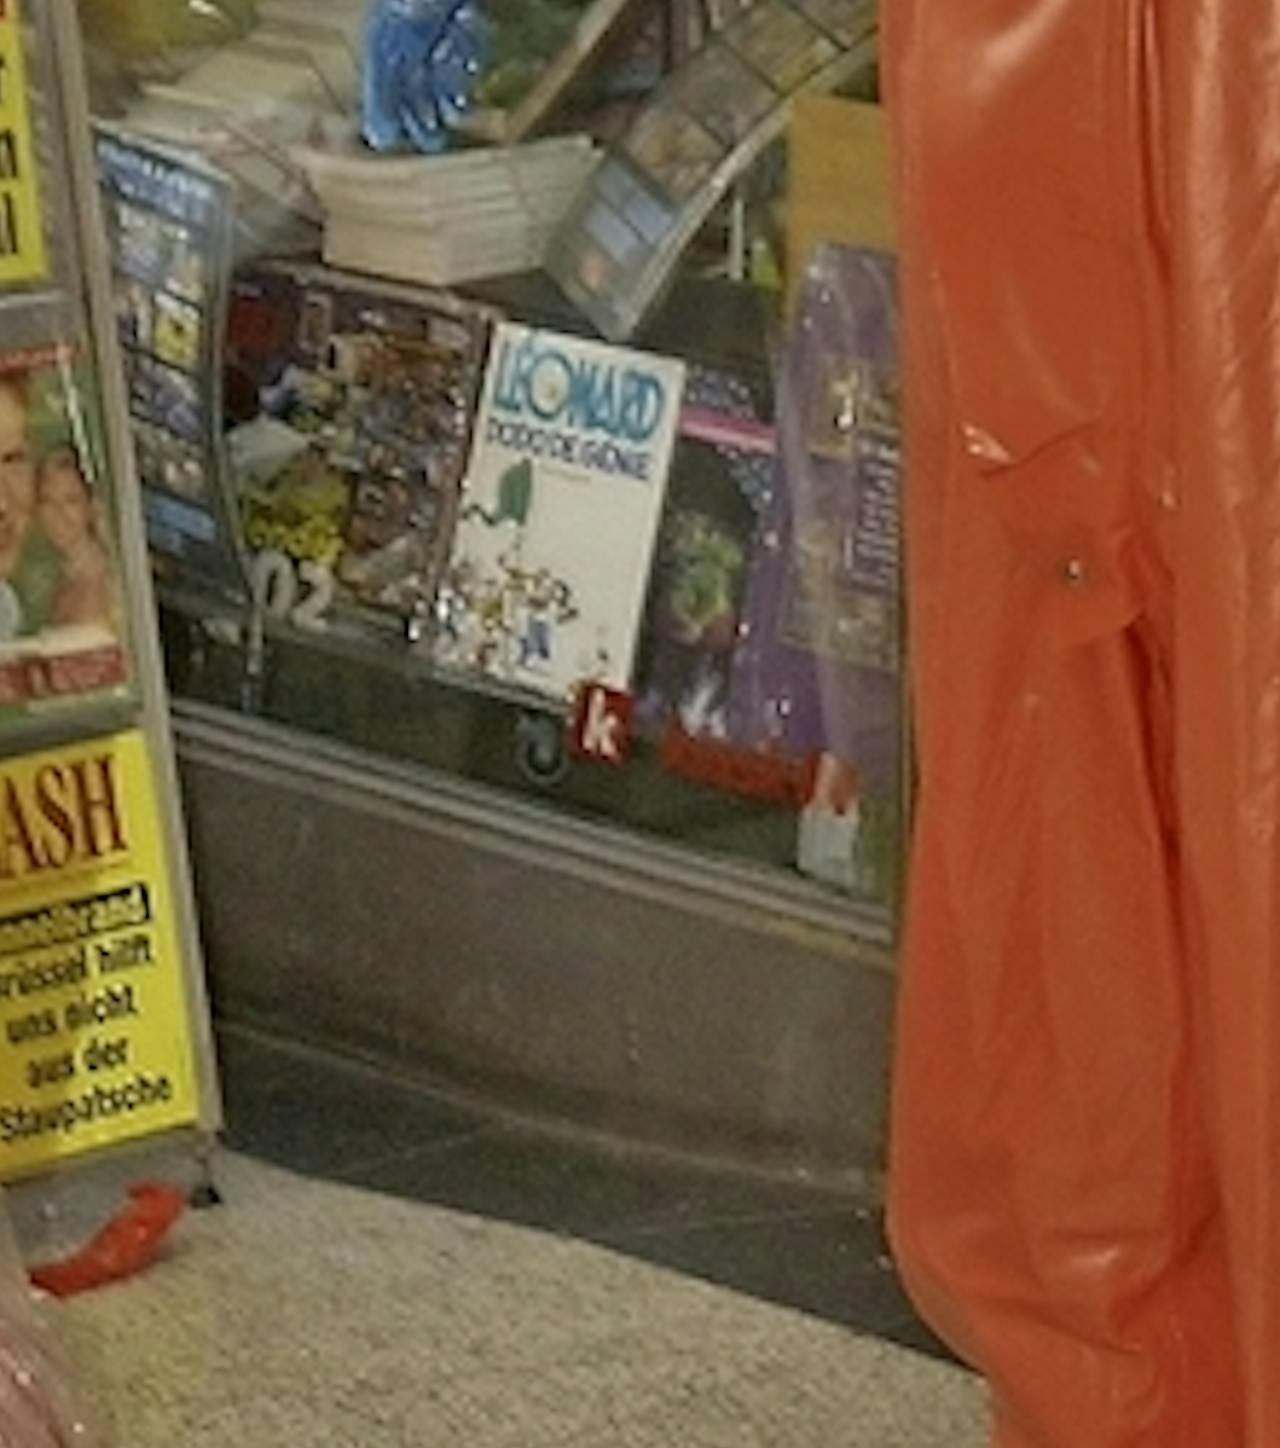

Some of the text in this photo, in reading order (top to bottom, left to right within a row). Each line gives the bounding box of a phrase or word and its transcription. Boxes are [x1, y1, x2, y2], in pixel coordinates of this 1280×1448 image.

[95, 934, 153, 975] hilft
[5, 986, 139, 1043] uns nicht
[26, 1036, 130, 1088] aus der
